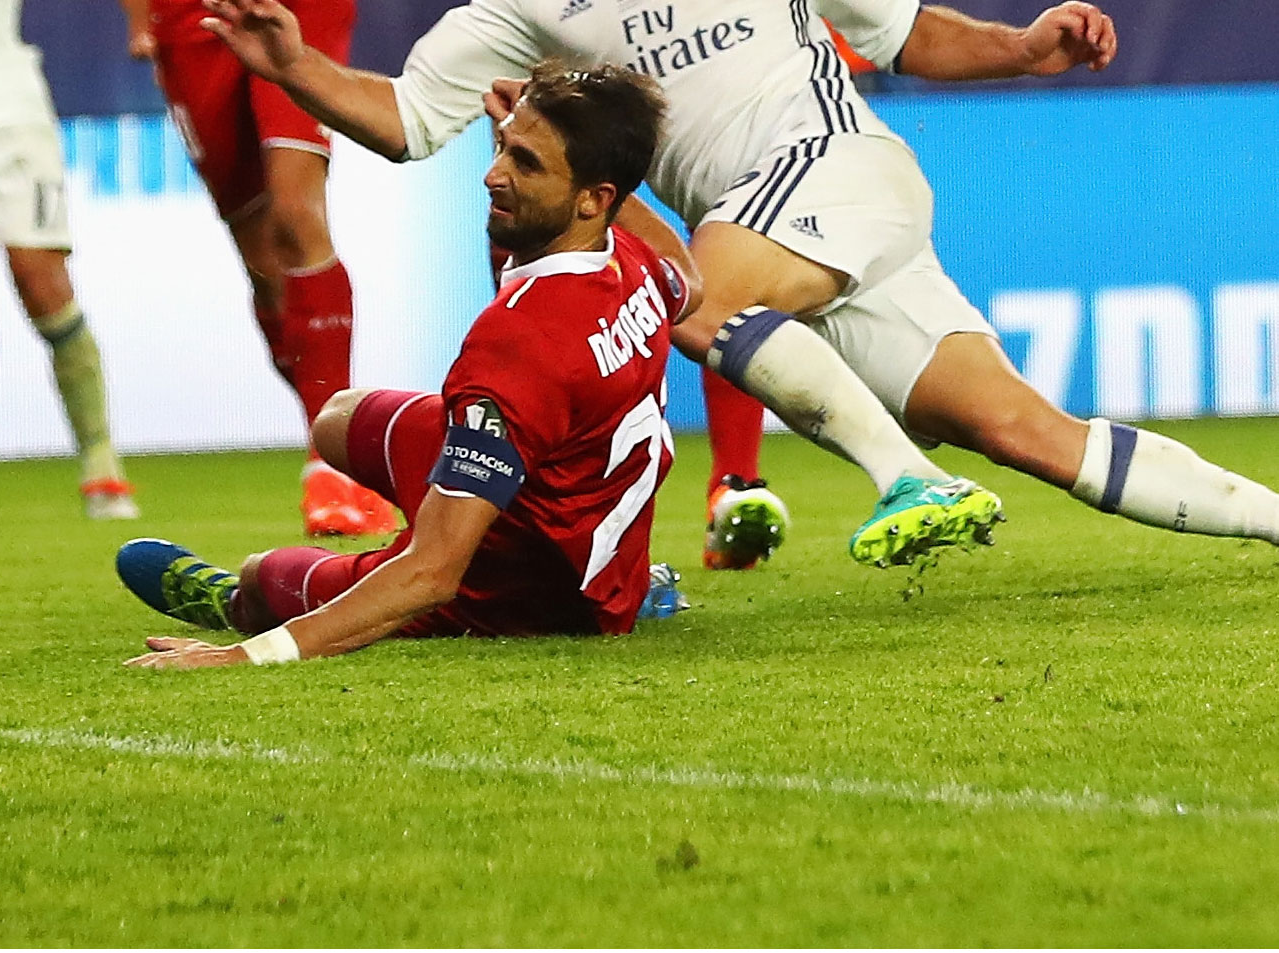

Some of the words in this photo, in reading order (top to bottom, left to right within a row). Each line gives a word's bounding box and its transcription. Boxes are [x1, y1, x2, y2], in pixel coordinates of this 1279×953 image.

[622, 5, 673, 44] Fly
[625, 17, 754, 78] irates
[484, 418, 501, 438] 5
[455, 446, 469, 459] TO
[470, 450, 514, 477] RACISM
